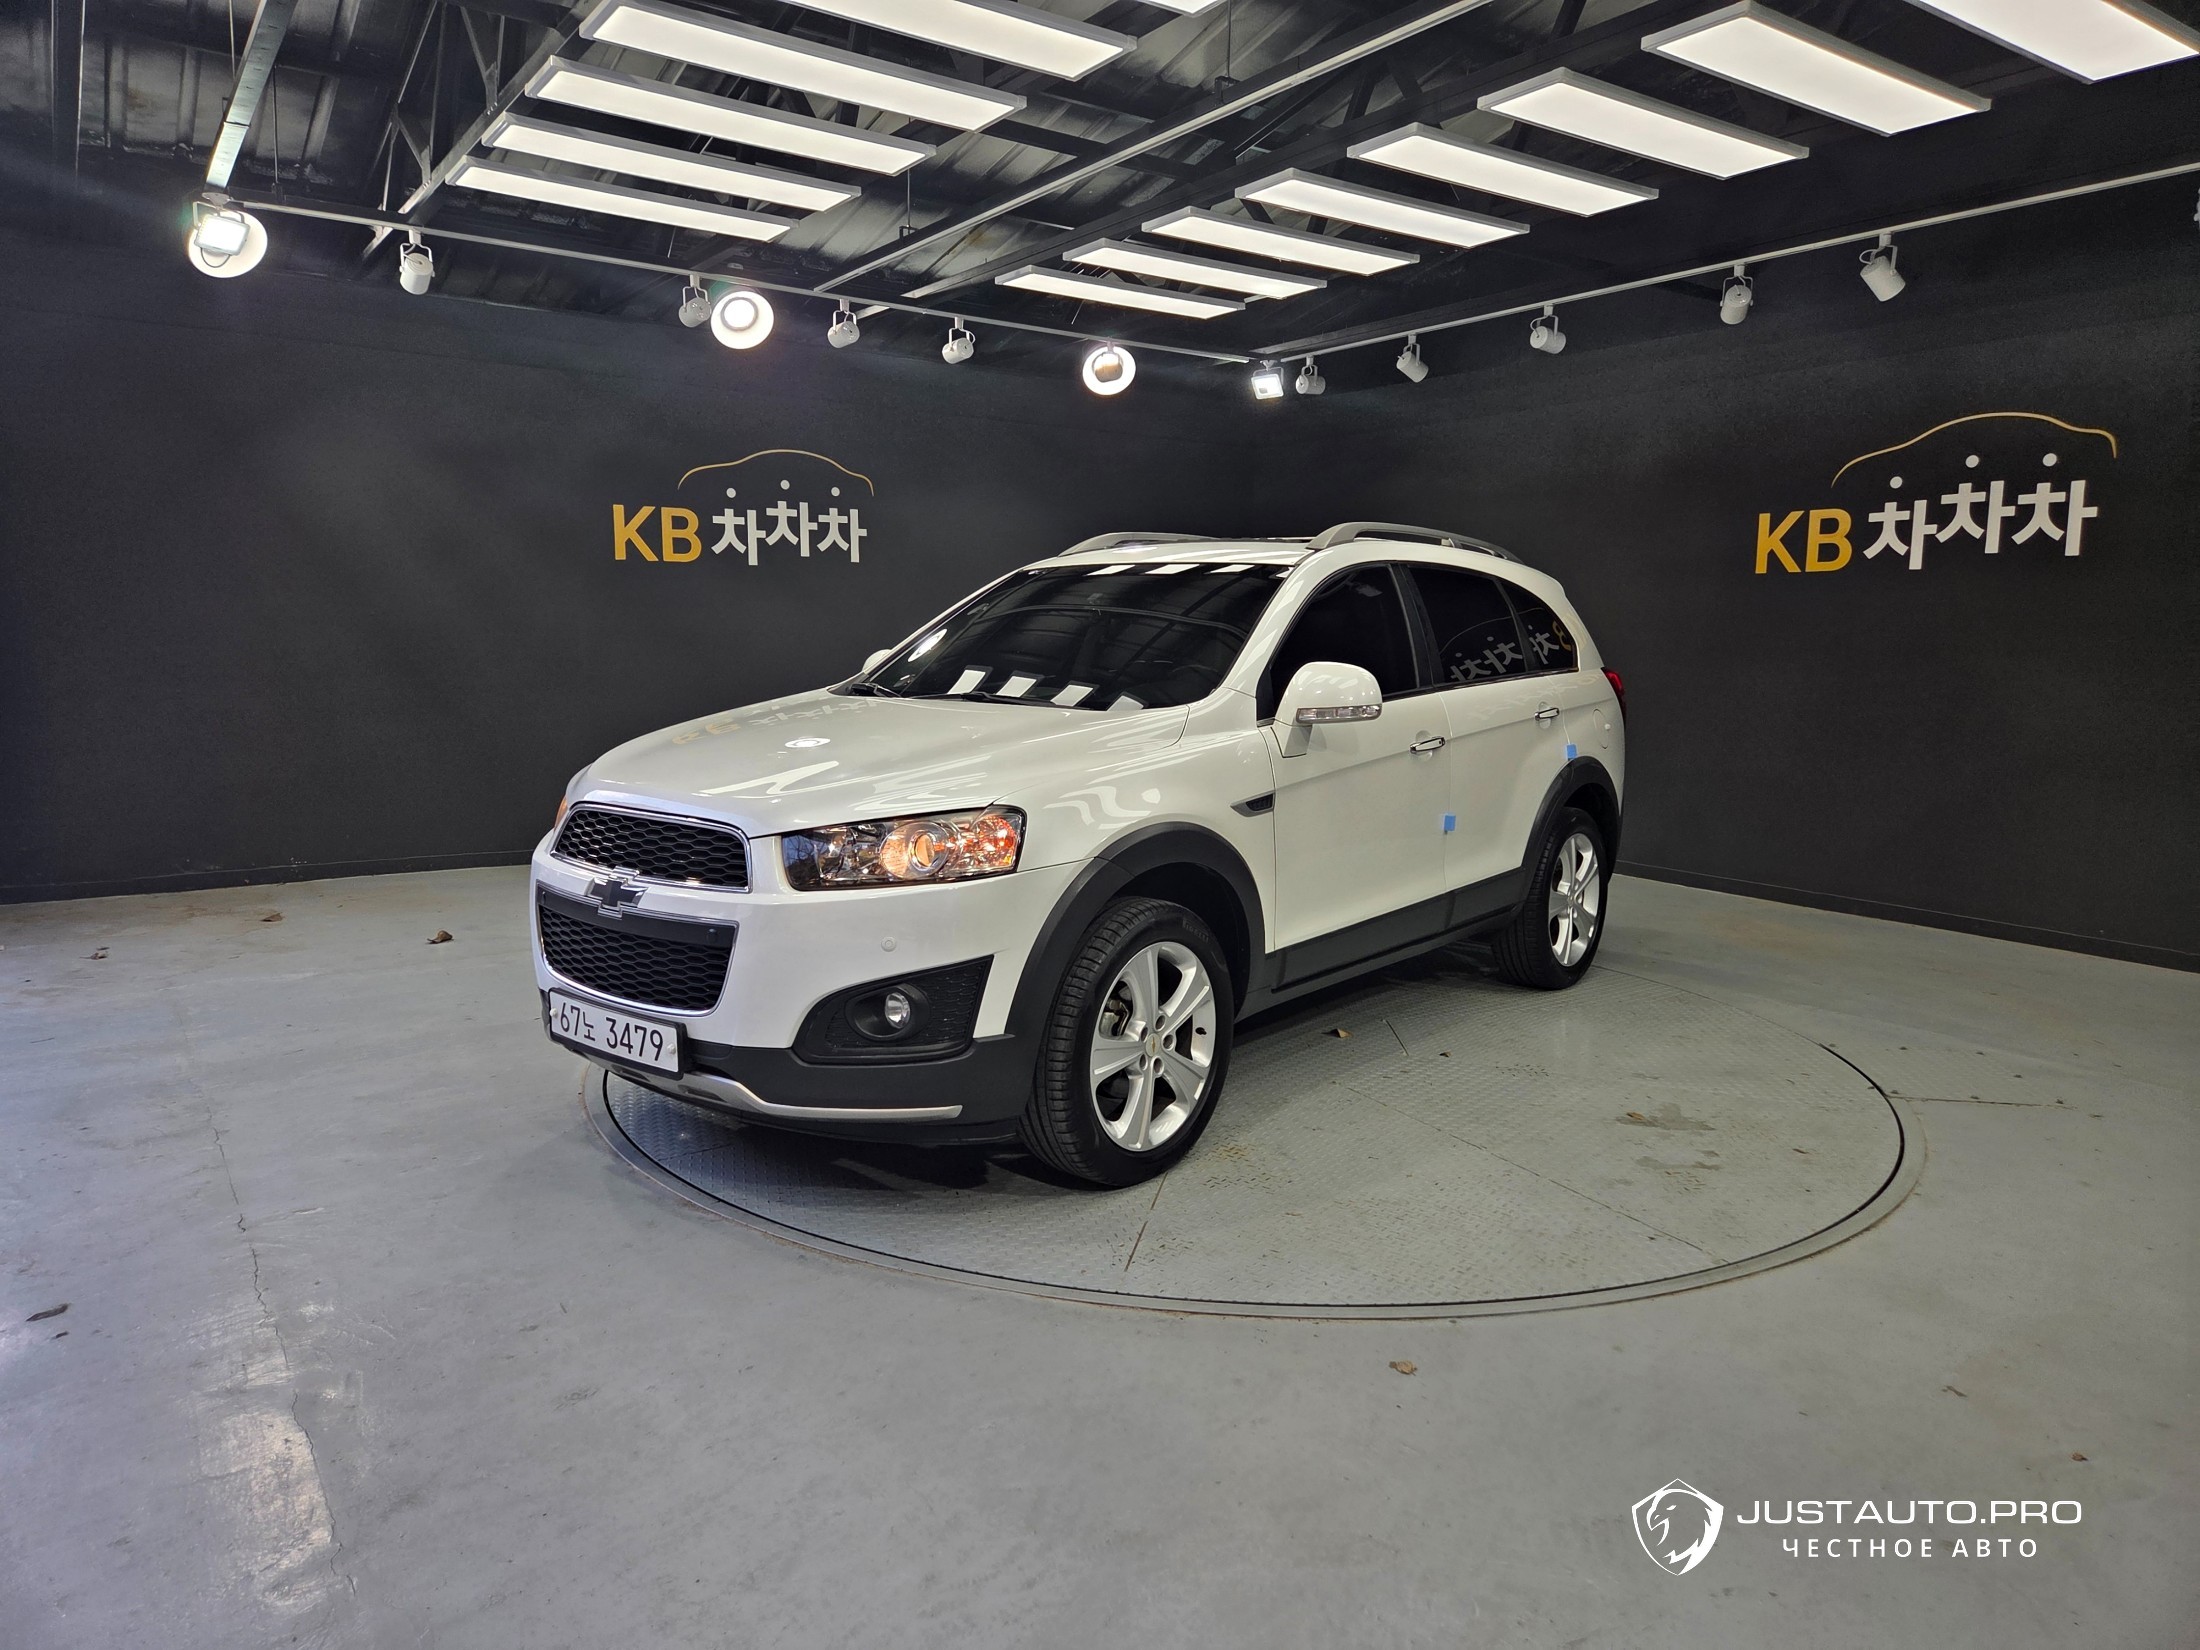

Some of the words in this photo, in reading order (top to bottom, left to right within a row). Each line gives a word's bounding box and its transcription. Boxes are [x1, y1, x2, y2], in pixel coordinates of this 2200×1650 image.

[612, 504, 702, 562] KB
[711, 500, 867, 566] 차차차
[1755, 508, 1852, 574] KB
[1863, 479, 2098, 570] 차차차
[560, 1002, 595, 1041] 67노
[605, 1016, 663, 1061] 3479
